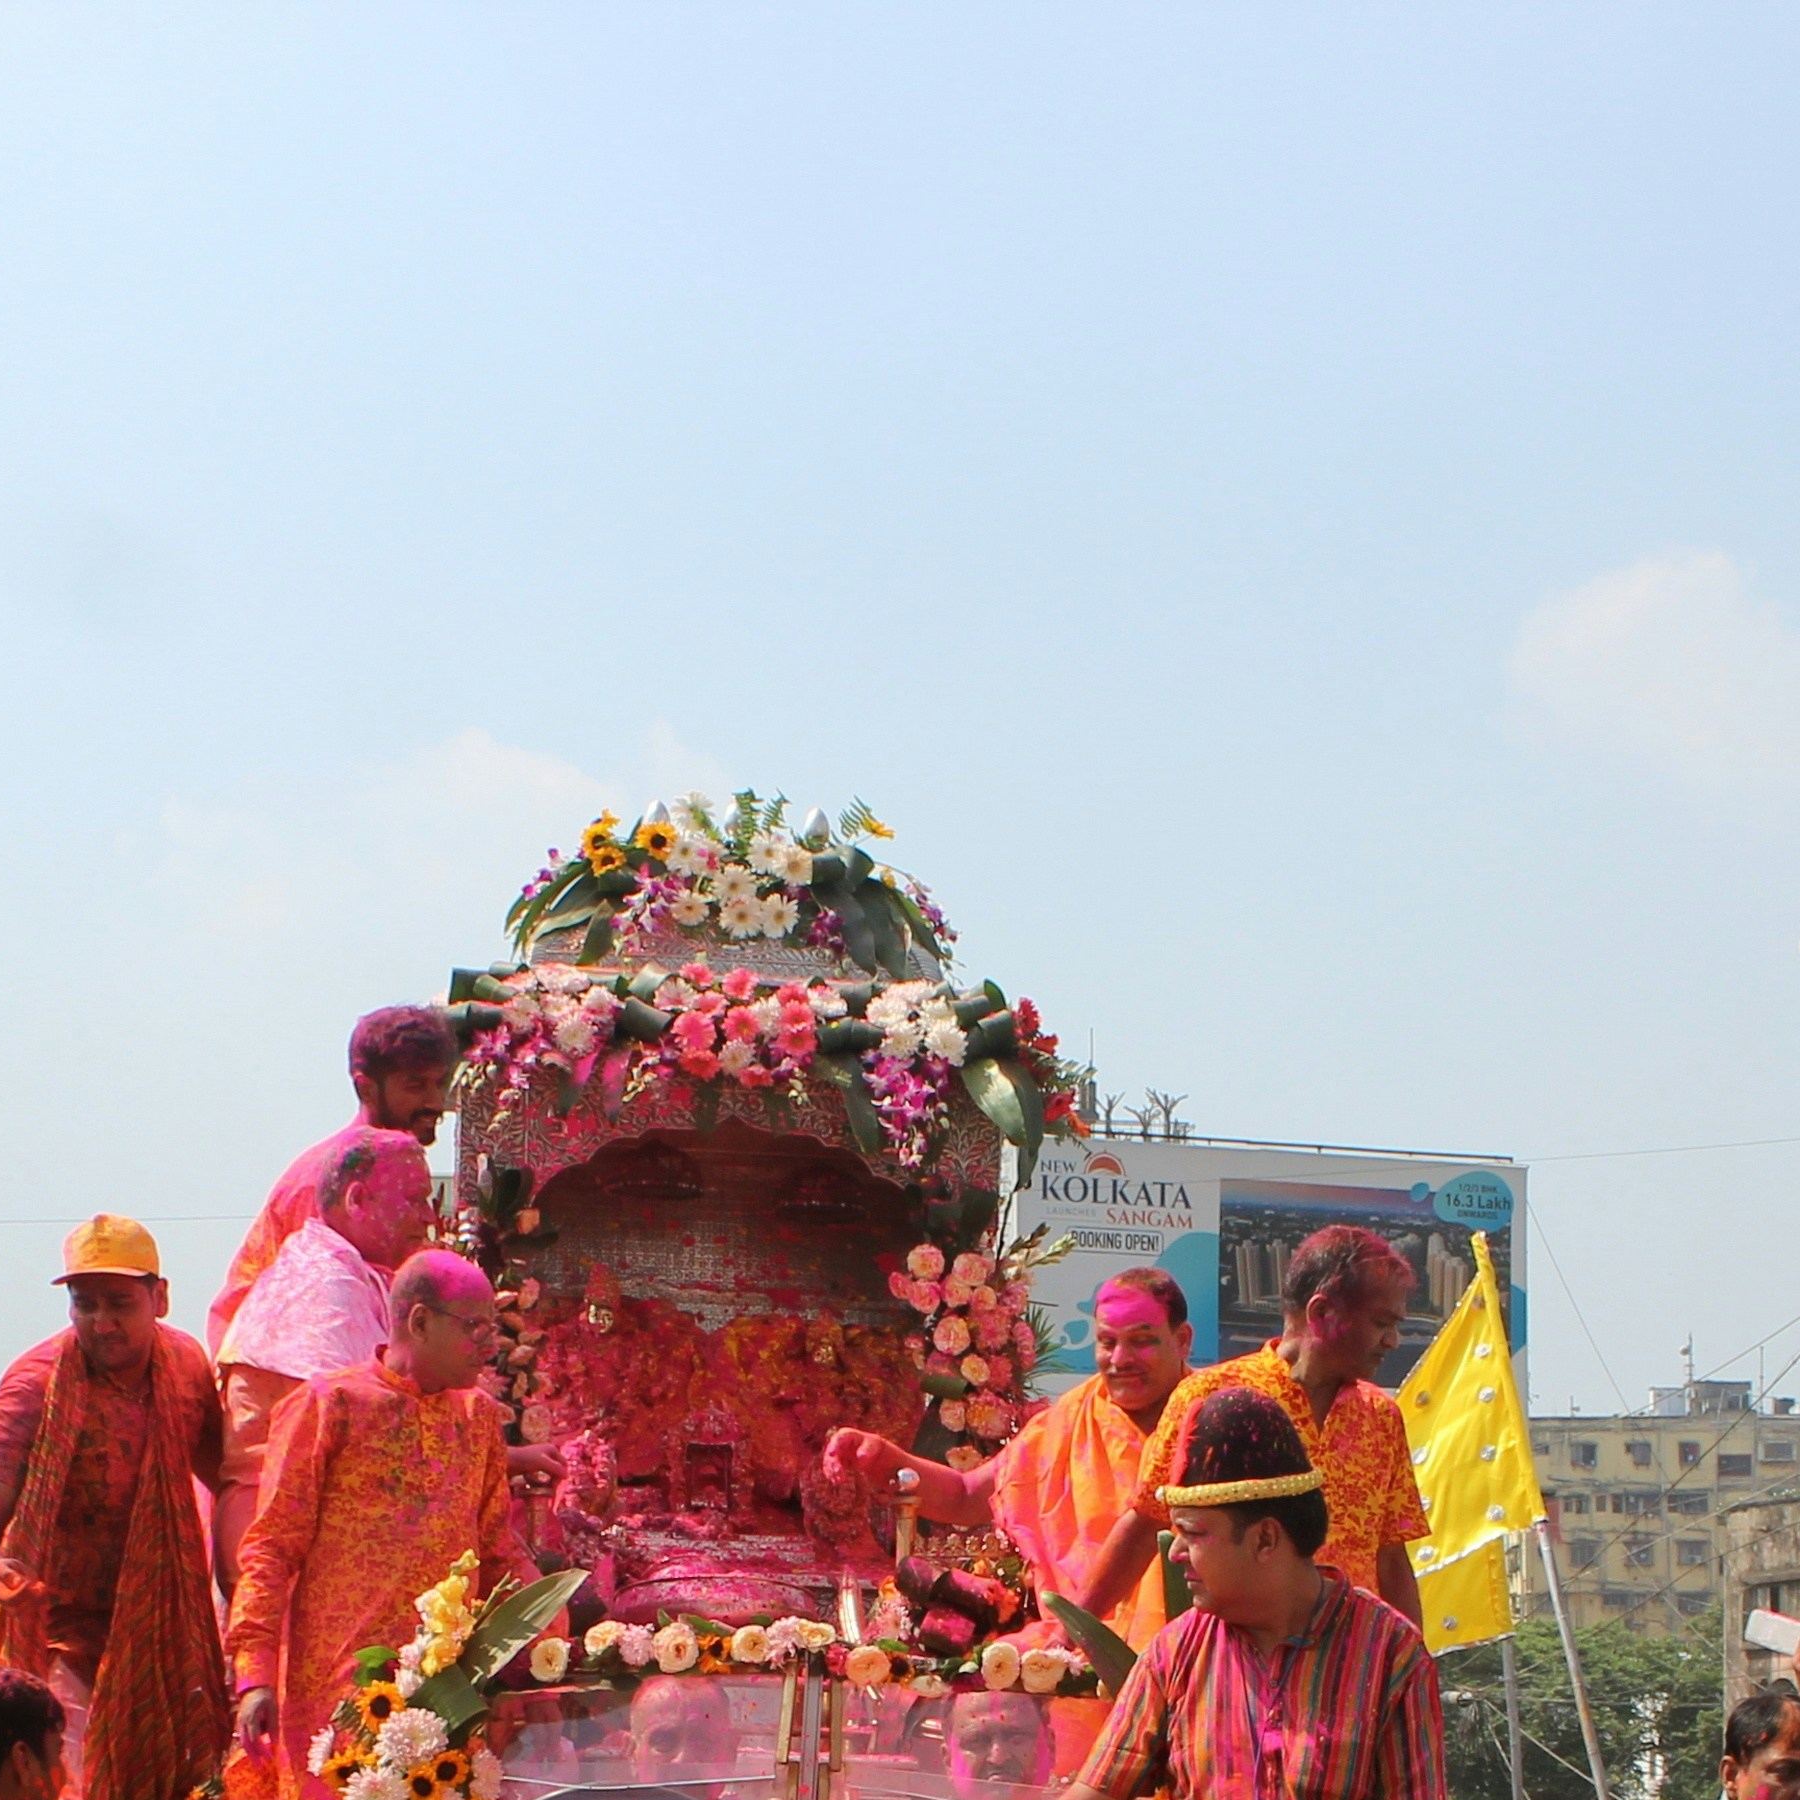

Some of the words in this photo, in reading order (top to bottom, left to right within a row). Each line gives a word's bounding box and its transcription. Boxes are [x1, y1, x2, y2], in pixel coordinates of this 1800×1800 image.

[1040, 1159, 1077, 1173] NEW
[1041, 1174, 1192, 1210] KOLKATA
[1445, 1193, 1474, 1208] 16.3
[1477, 1195, 1511, 1211] Lakh
[1046, 1206, 1097, 1218] LAUNCHES
[1106, 1208, 1193, 1229] SANGAM
[1125, 1235, 1160, 1252] OPEN!
